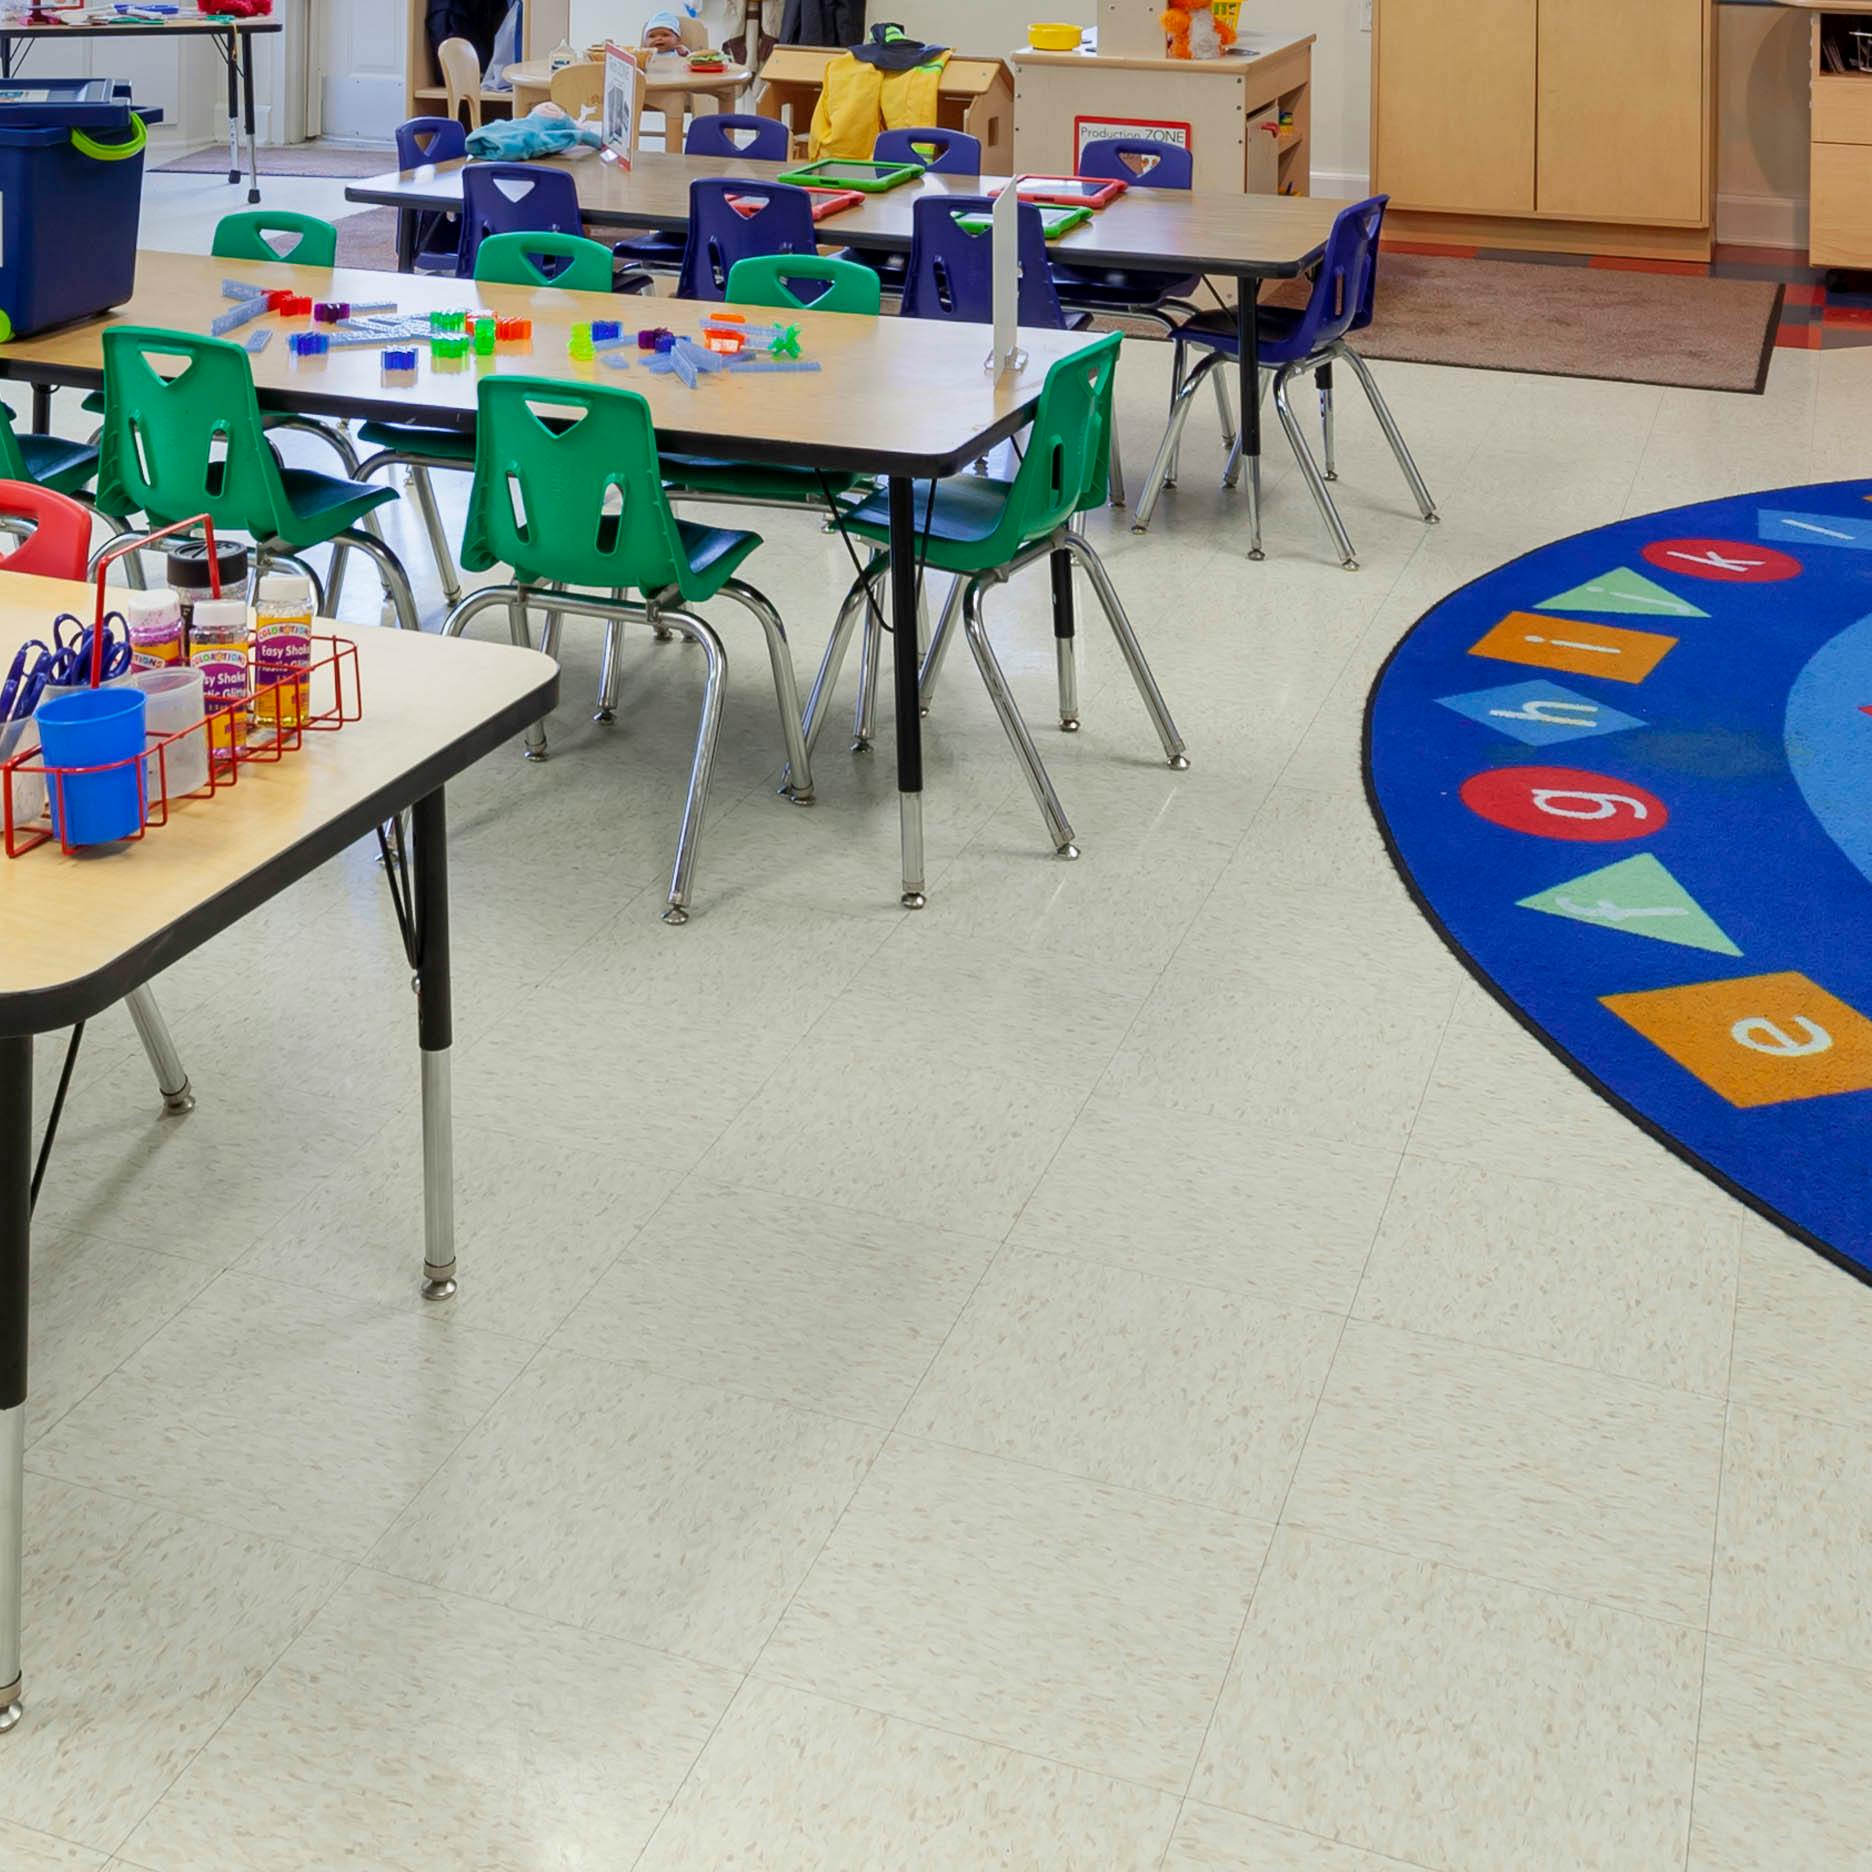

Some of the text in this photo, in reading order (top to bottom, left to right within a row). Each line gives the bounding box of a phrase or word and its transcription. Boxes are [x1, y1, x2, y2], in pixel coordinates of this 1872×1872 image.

[1080, 126, 1185, 144] Production ZONE
[1666, 549, 1768, 572] k
[261, 644, 284, 659] Easy
[1488, 699, 1601, 728] h
[1530, 786, 1650, 821] g
[1552, 891, 1692, 925] f
[1729, 1011, 1836, 1059] e
